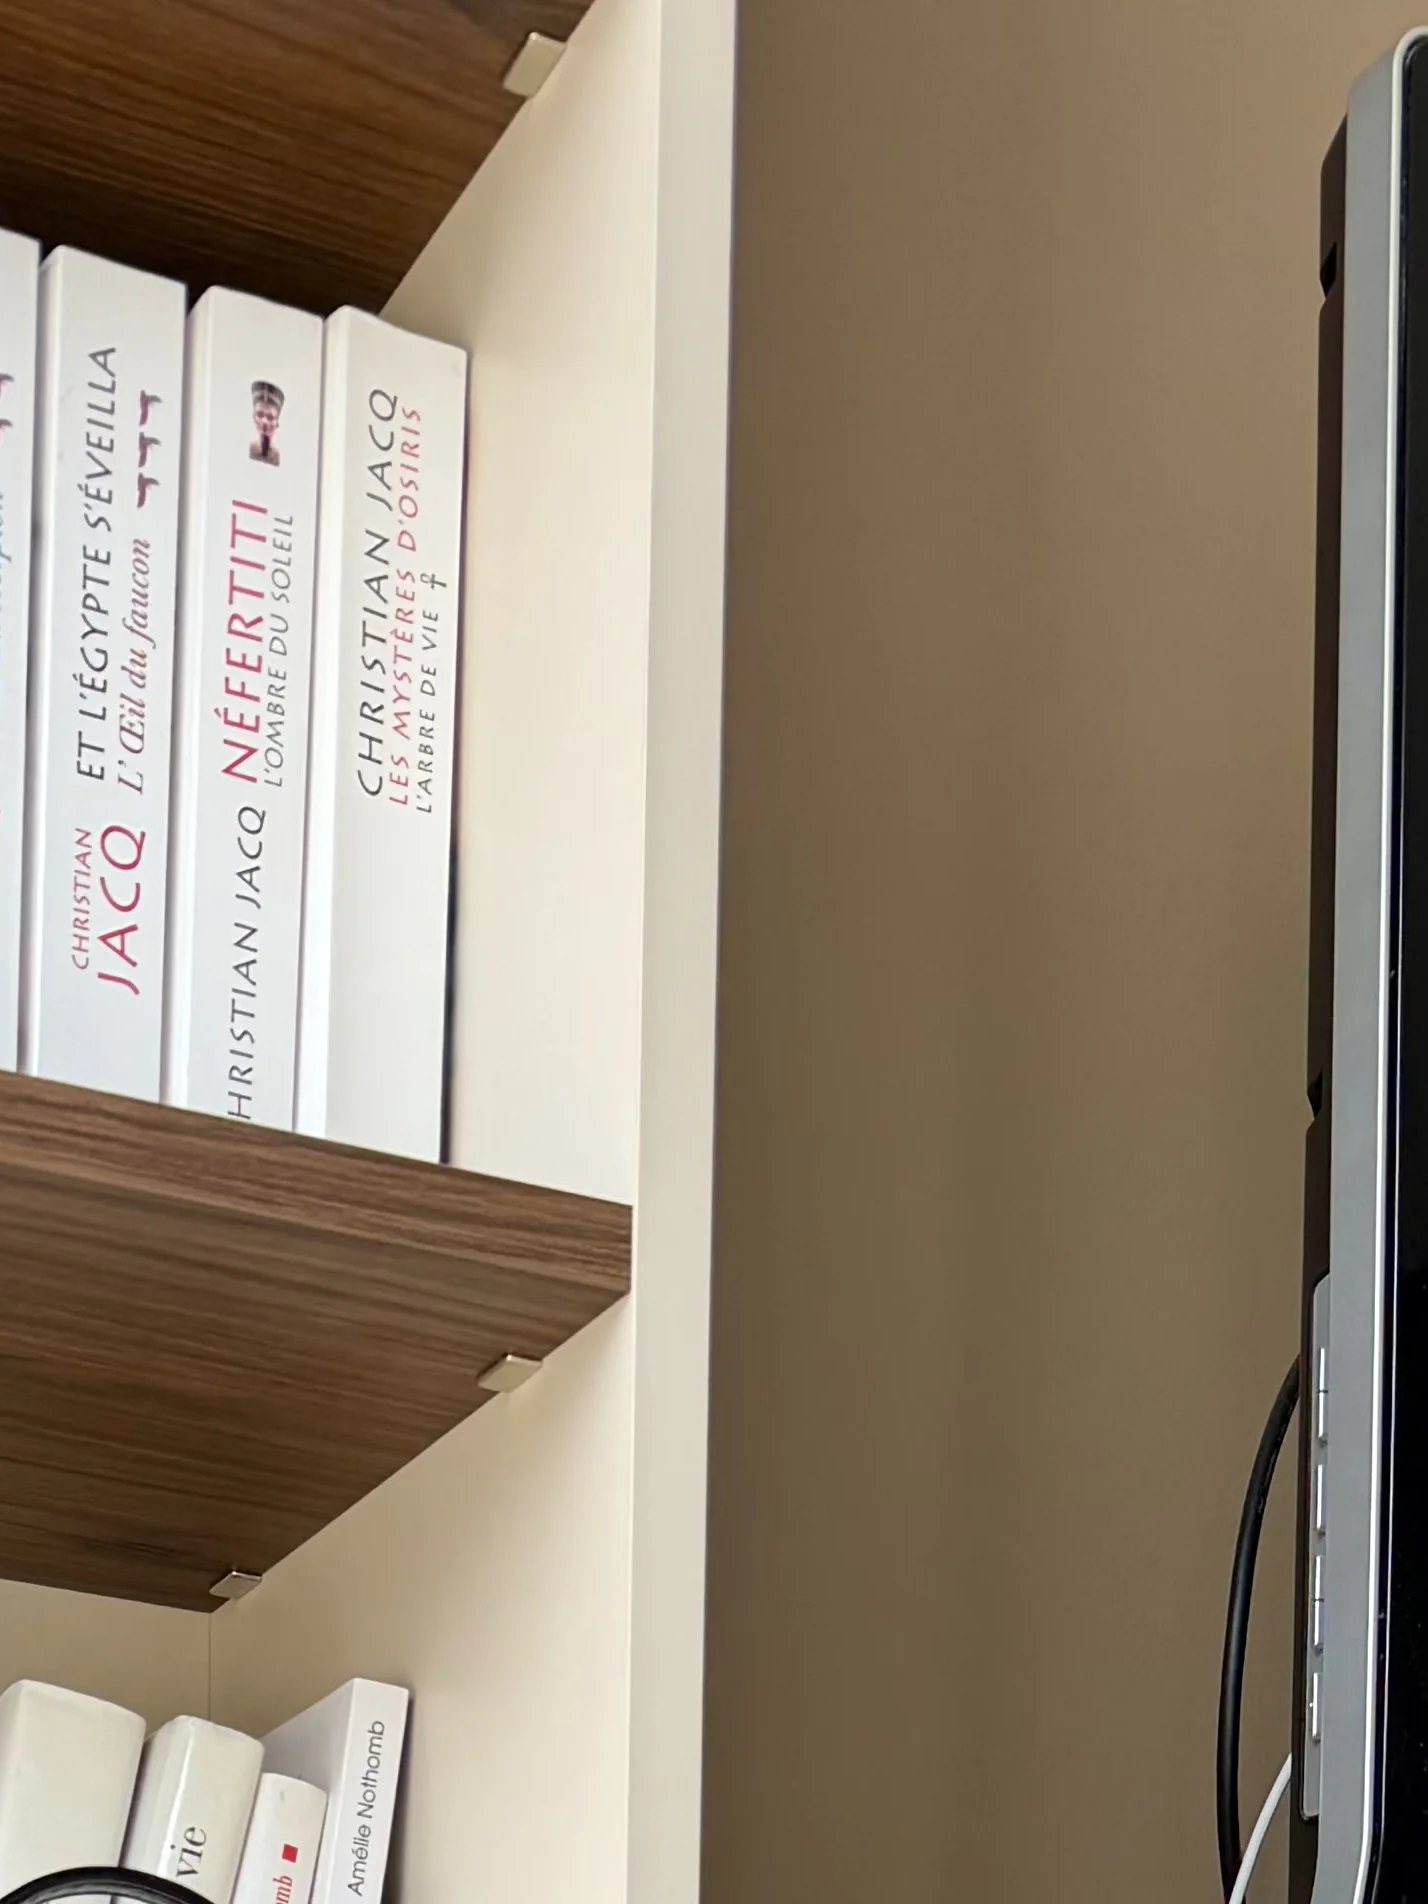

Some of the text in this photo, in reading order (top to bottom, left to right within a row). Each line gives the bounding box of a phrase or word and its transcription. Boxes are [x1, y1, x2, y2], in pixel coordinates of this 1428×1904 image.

[72, 347, 116, 780] ET L'ÉGYPTE S'ÉVEILLA
[120, 648, 147, 689] du
[121, 538, 156, 650] faucon
[212, 498, 270, 784] NÉFERTITI
[263, 516, 293, 787] L'OMBRE DU SOLEIL
[356, 389, 398, 797] CHRISTIAN JACQ
[388, 407, 421, 805] LES MYSTÈRES D'OSIRIS
[416, 610, 439, 813] L'ARBRE DE VIE
[71, 827, 92, 970] CHRISTIAN
[97, 825, 146, 995] JACQ
[227, 806, 266, 1120] HRISTIAN JACQ
[347, 1720, 385, 1897] Amélie Nothomb
